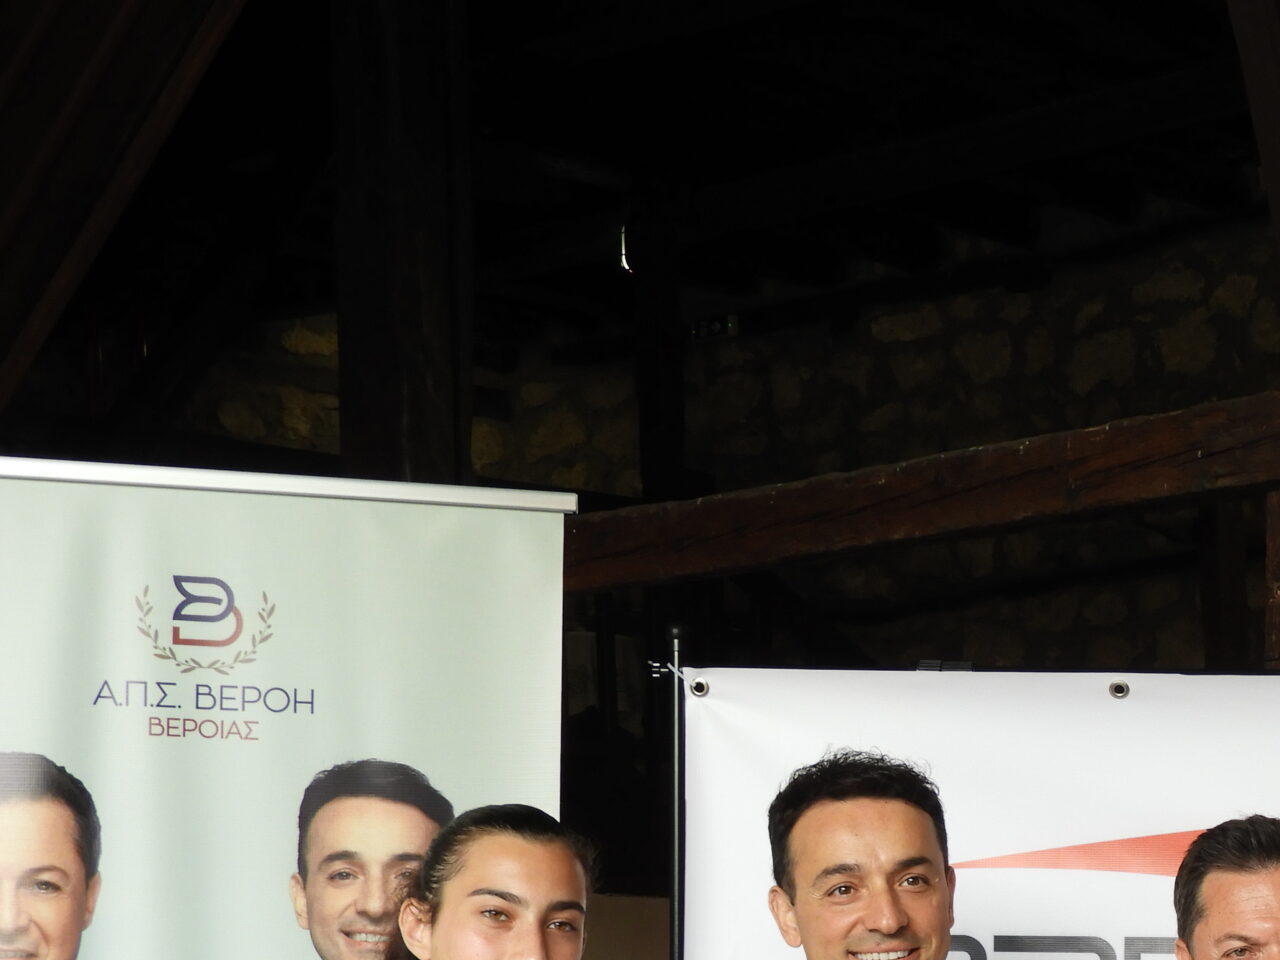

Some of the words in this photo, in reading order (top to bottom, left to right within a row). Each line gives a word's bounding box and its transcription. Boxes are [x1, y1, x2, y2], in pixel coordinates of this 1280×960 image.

[93, 679, 182, 709] Α.Π.Σ.
[195, 683, 315, 715] ΒΕΡΟΗ
[148, 716, 260, 741] ΒΕΡΟΙΑΣ
